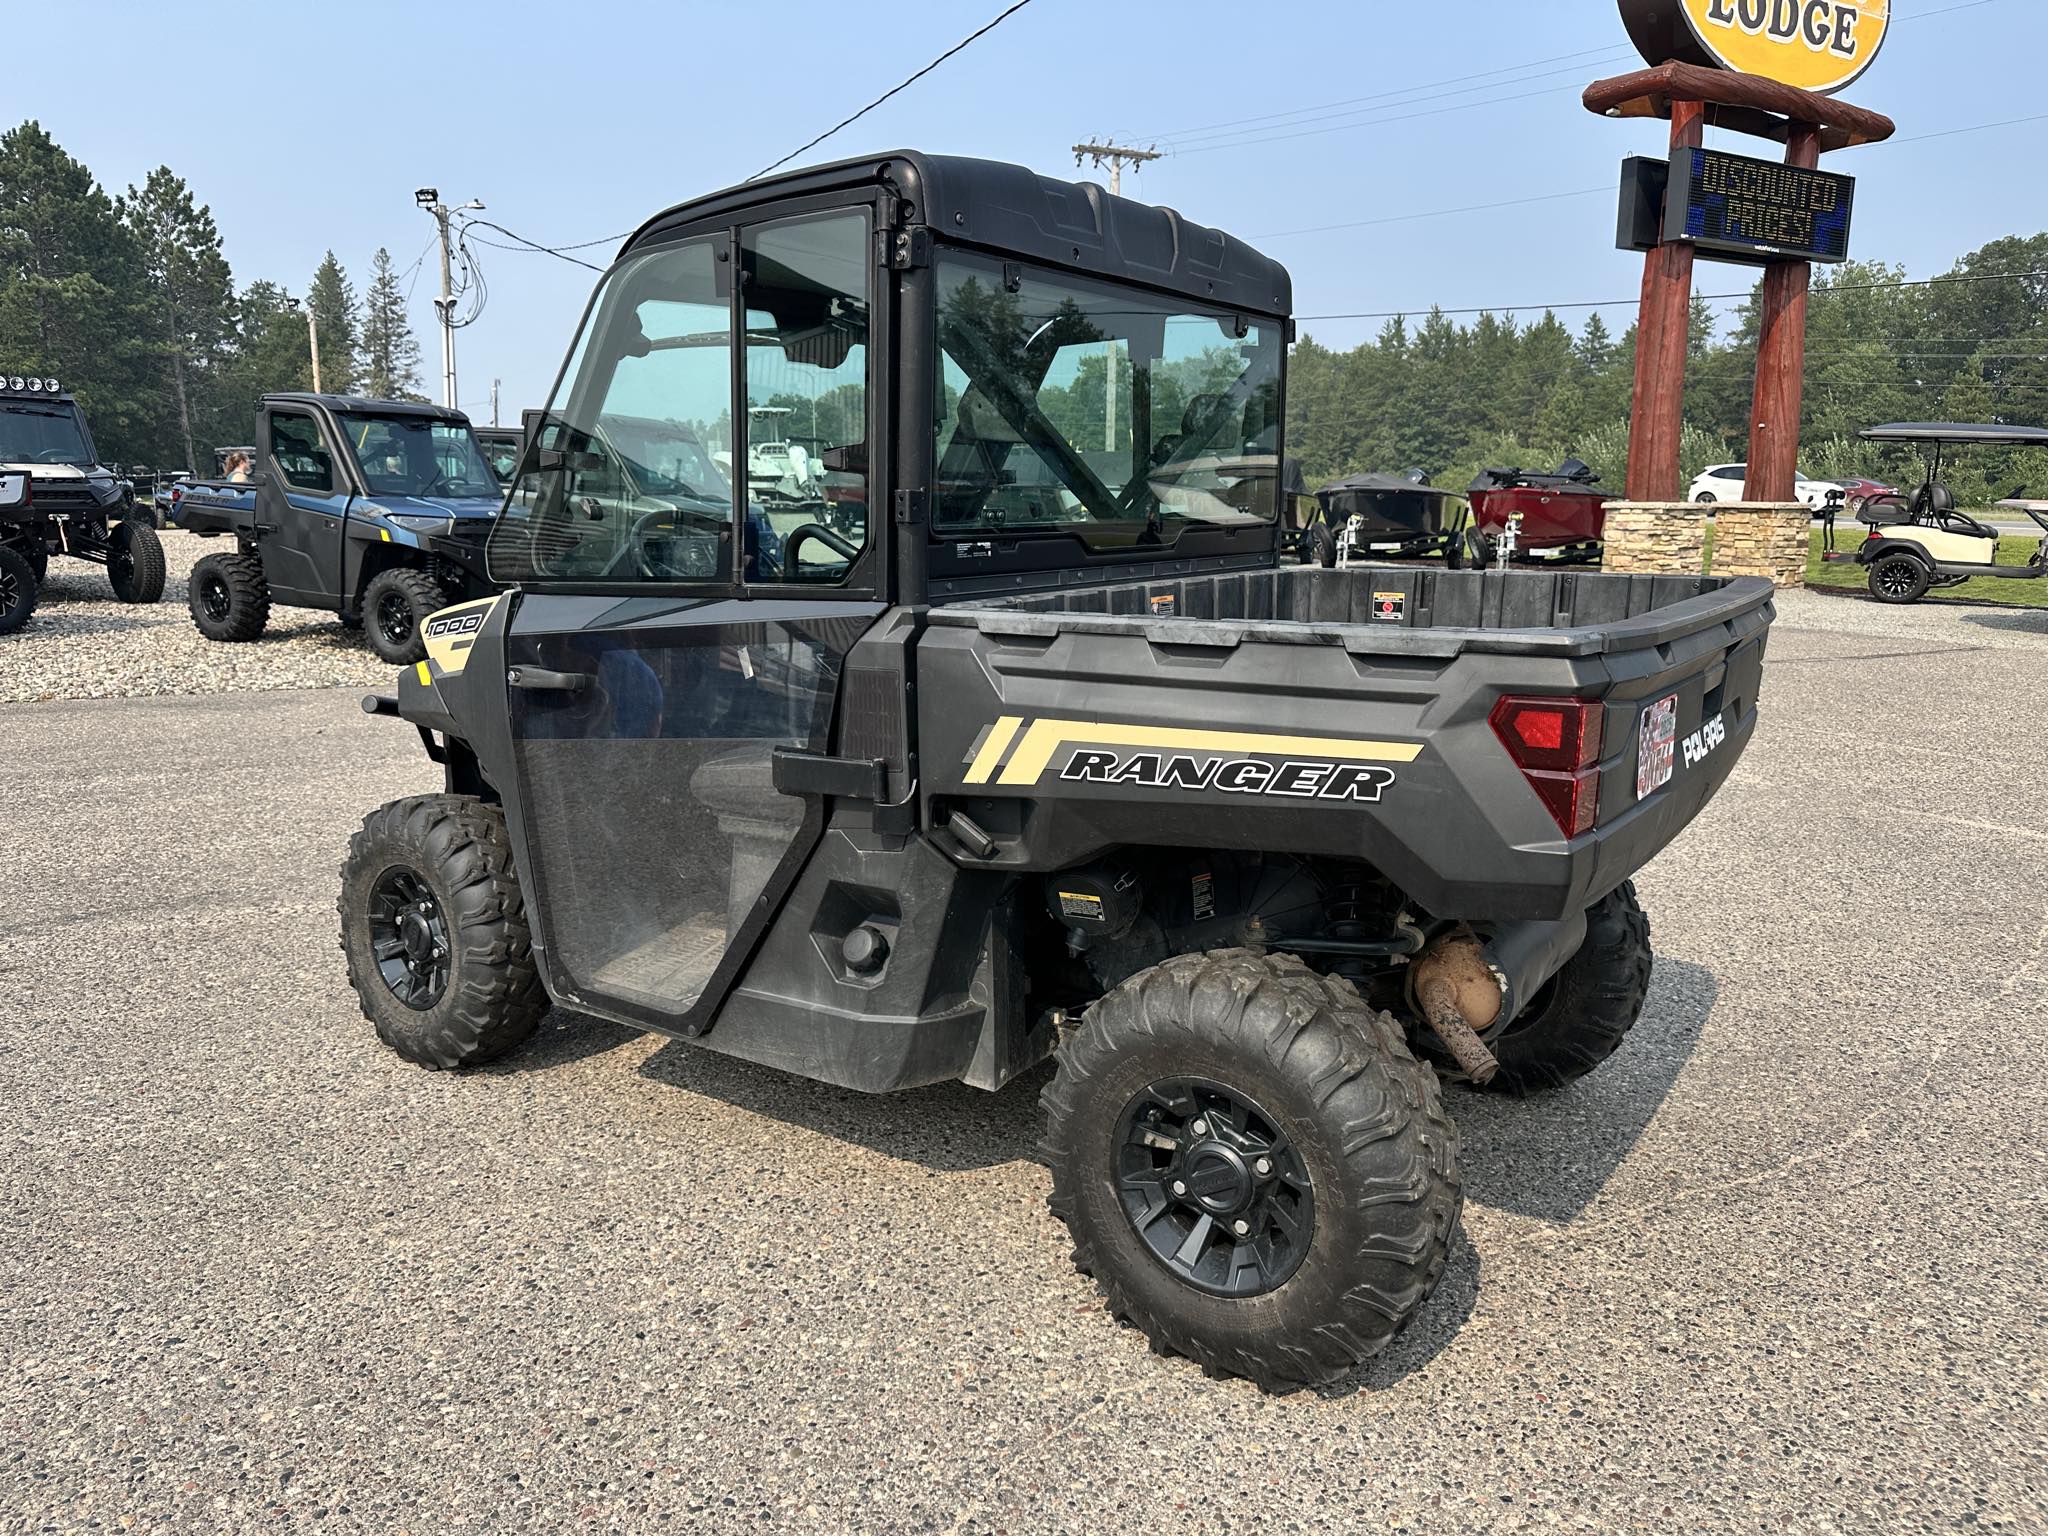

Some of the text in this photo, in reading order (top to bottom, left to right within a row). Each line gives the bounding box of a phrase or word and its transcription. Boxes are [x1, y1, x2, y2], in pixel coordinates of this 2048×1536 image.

[1708, 0, 1857, 55] LODGE
[1702, 155, 1838, 212] DISCOUNTED
[426, 614, 482, 639] 1000
[1681, 712, 1725, 769] POLARIS
[1059, 749, 1396, 803] RANGER
